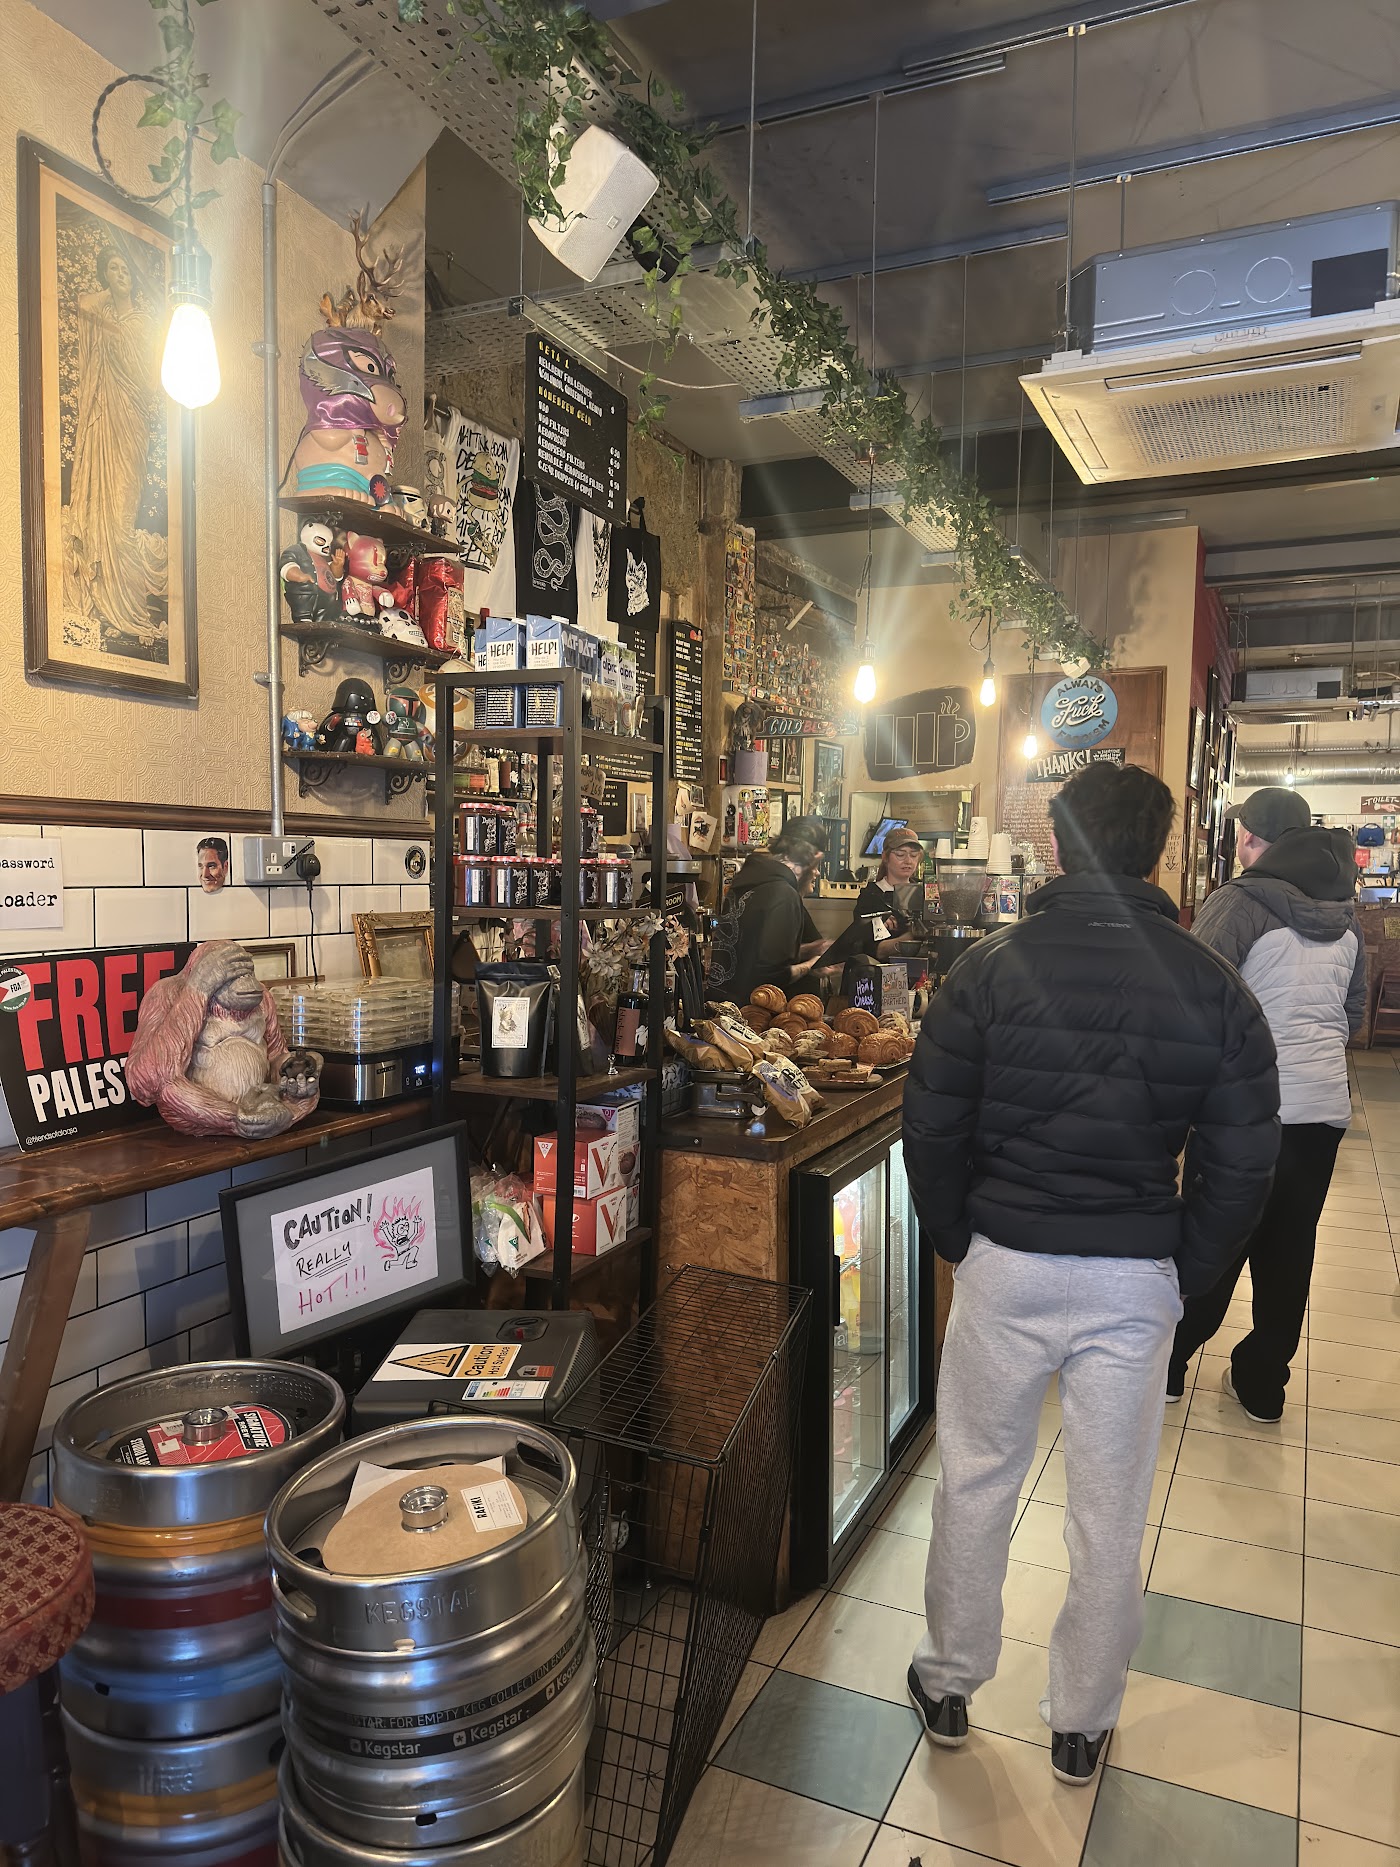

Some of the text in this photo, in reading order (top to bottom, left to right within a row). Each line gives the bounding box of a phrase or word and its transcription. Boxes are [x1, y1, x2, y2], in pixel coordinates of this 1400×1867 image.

[490, 643, 514, 657] HELP!
[532, 642, 556, 656] HELP!
[1057, 680, 1104, 697] ALWAYS
[1052, 694, 1106, 728] Fuck
[770, 718, 804, 734] COLD
[1036, 749, 1091, 778] THANKS!
[1366, 796, 1396, 806] TOILET
[0, 857, 54, 868] assword
[465, 1346, 495, 1376] Caution
[487, 1346, 510, 1374] Hot Surface
[240, 1421, 250, 1439] BREW
[244, 1412, 267, 1447] SIGNATURE
[470, 1497, 488, 1518] RAFIKI
[389, 1717, 413, 1728] FOR
[418, 1709, 459, 1726] EMPTY
[463, 1701, 486, 1716] KEG
[489, 1662, 549, 1706] COLLECTION
[470, 1706, 524, 1742] Kegstar
[365, 1742, 420, 1759] Kegstar
